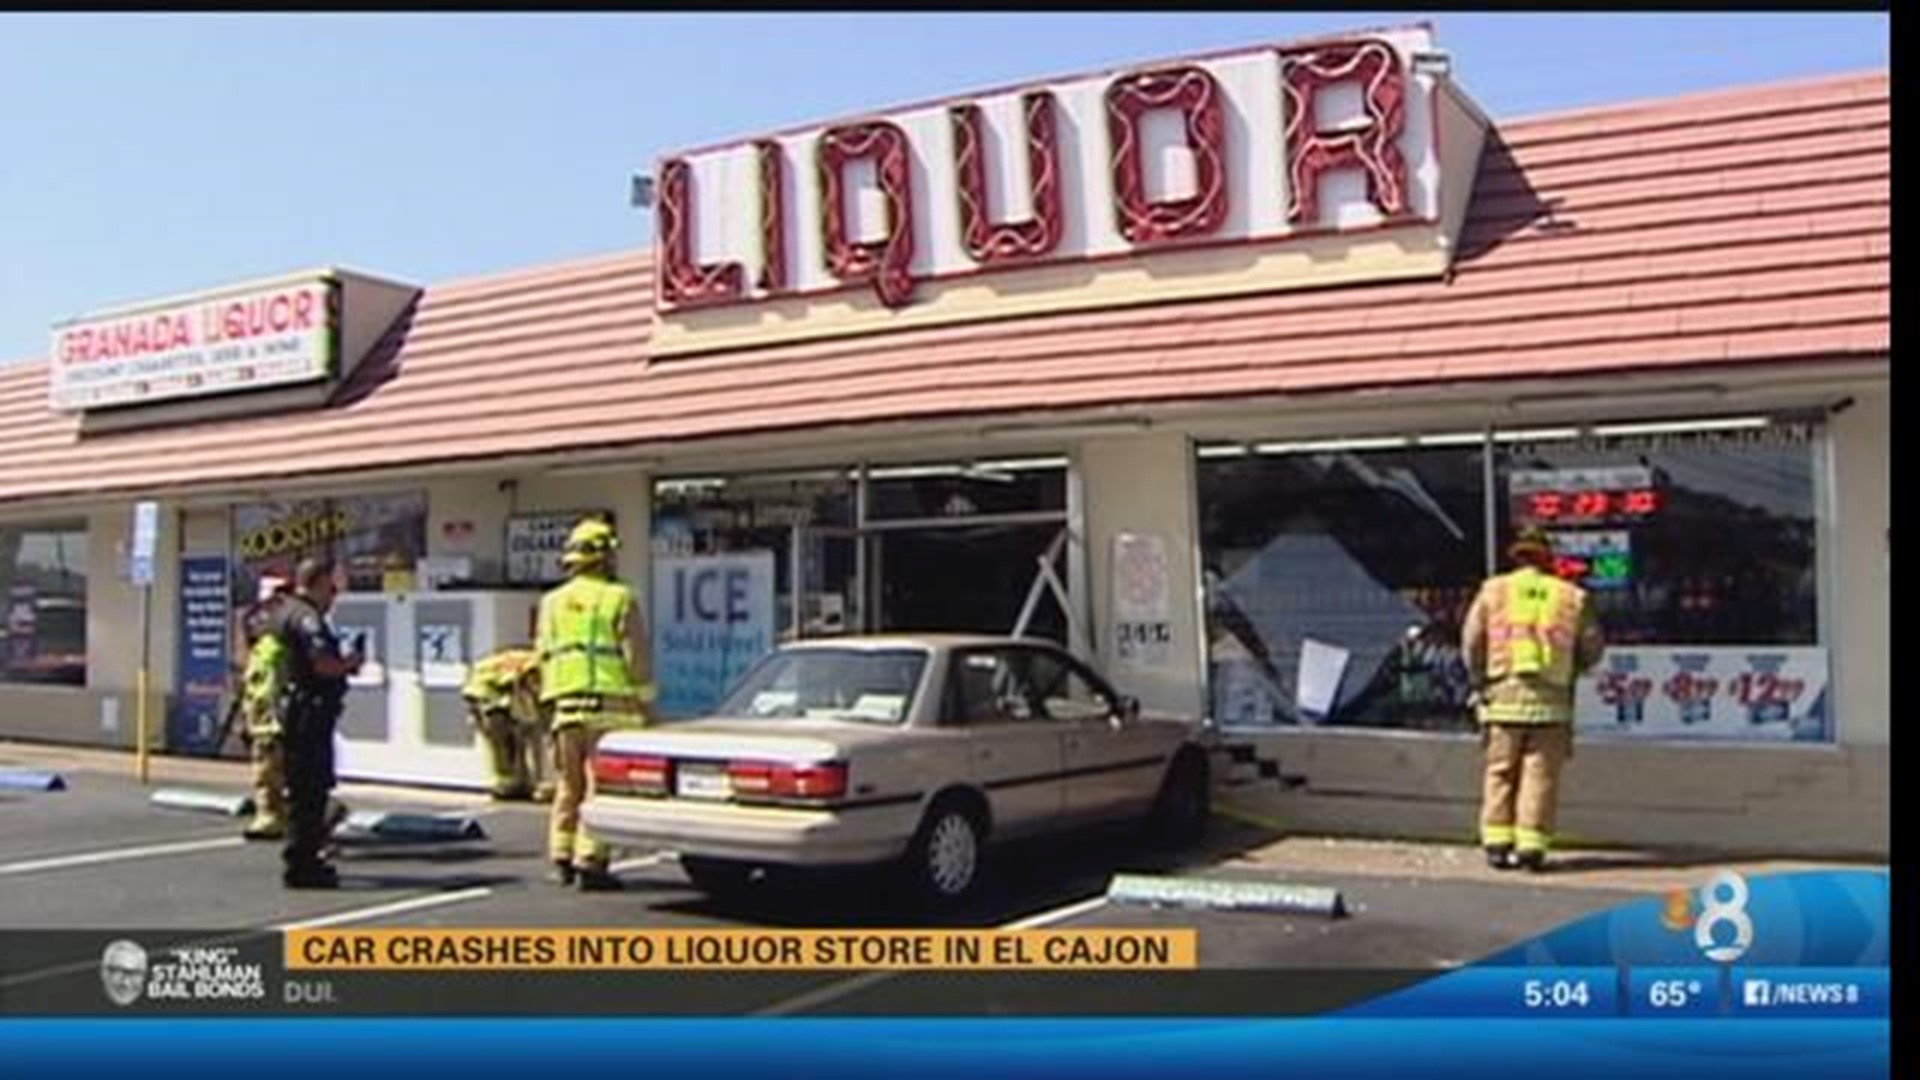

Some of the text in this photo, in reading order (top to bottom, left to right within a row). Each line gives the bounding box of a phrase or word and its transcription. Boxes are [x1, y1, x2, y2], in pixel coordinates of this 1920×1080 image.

[658, 38, 1410, 307] LIQUOR
[60, 289, 313, 364] GRANADA LIQUOR
[673, 567, 751, 624] ICE
